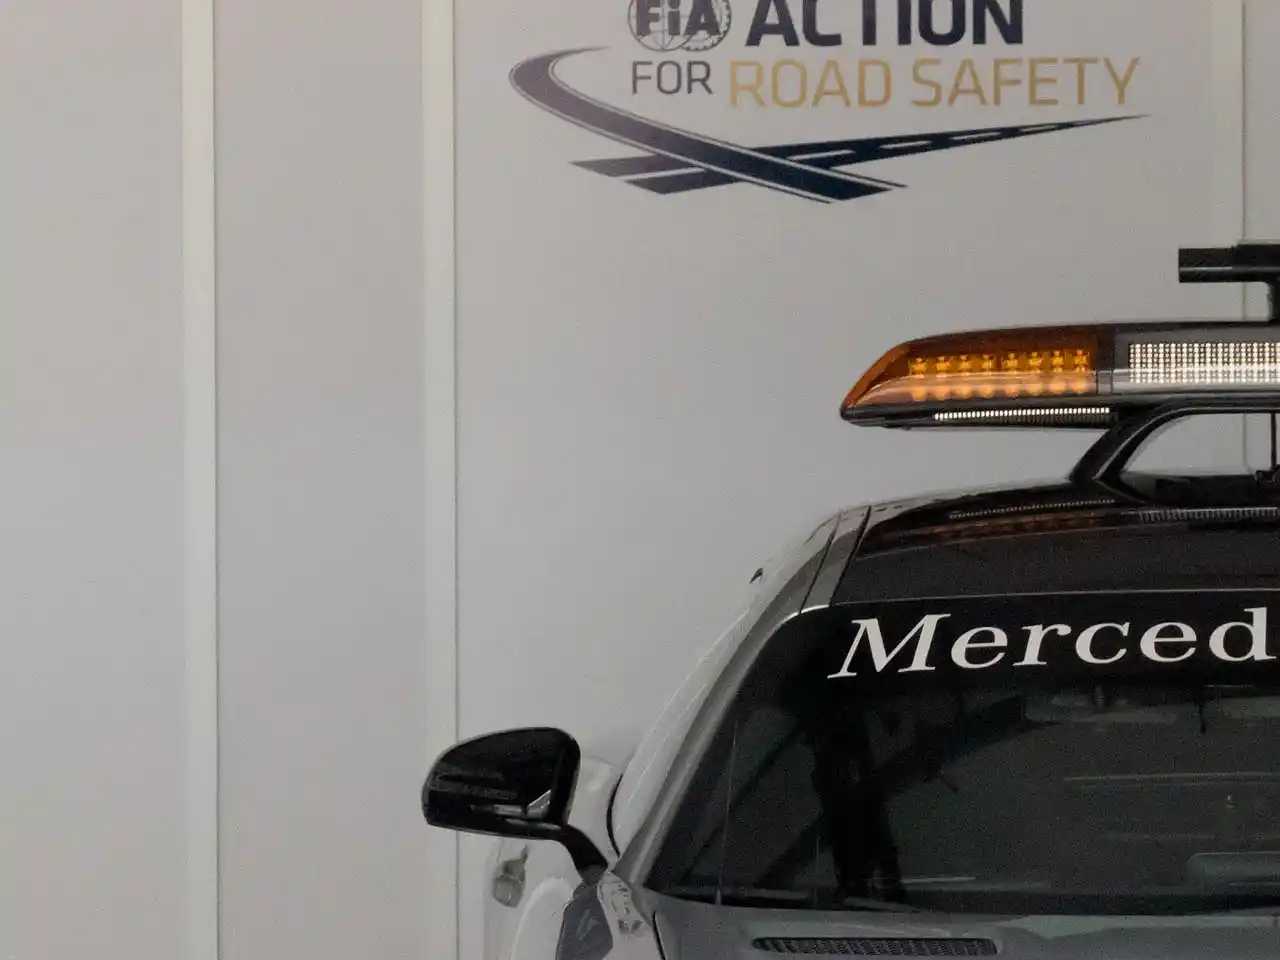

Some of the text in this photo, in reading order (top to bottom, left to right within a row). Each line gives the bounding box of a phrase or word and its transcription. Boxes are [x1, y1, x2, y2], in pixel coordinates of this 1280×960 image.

[744, 0, 1024, 47] ACTION
[631, 55, 1140, 108] FOR ROAD SAFETY
